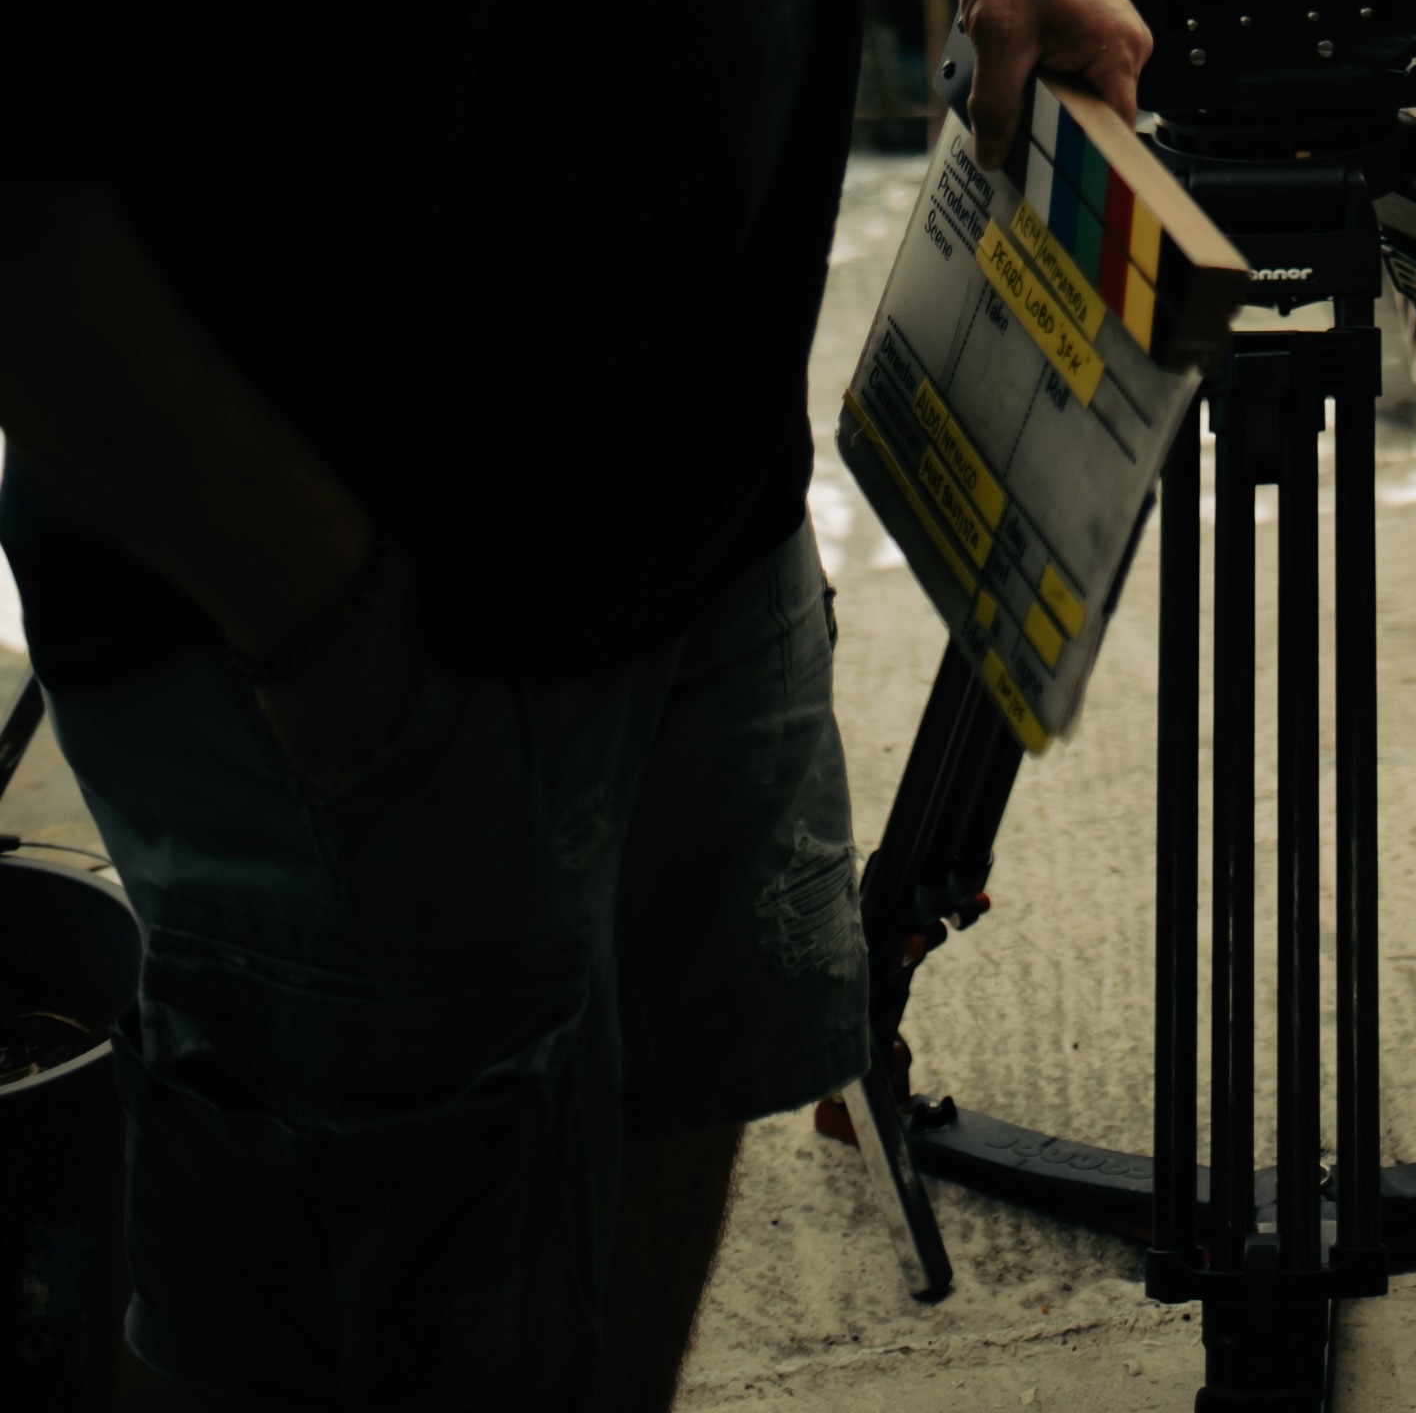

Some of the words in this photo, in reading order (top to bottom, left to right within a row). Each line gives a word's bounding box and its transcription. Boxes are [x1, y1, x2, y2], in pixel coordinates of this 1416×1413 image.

[950, 134, 994, 210] Company
[936, 170, 984, 242] Productio
[924, 209, 952, 261] Scene
[985, 288, 1008, 335] Take
[989, 240, 1022, 297] PERRO
[1024, 288, 1054, 334] LOBO
[880, 329, 917, 393] Director
[1045, 368, 1071, 412] Roll
[1006, 517, 1027, 566] day
[991, 553, 1010, 585] int
[965, 625, 987, 663] dat
